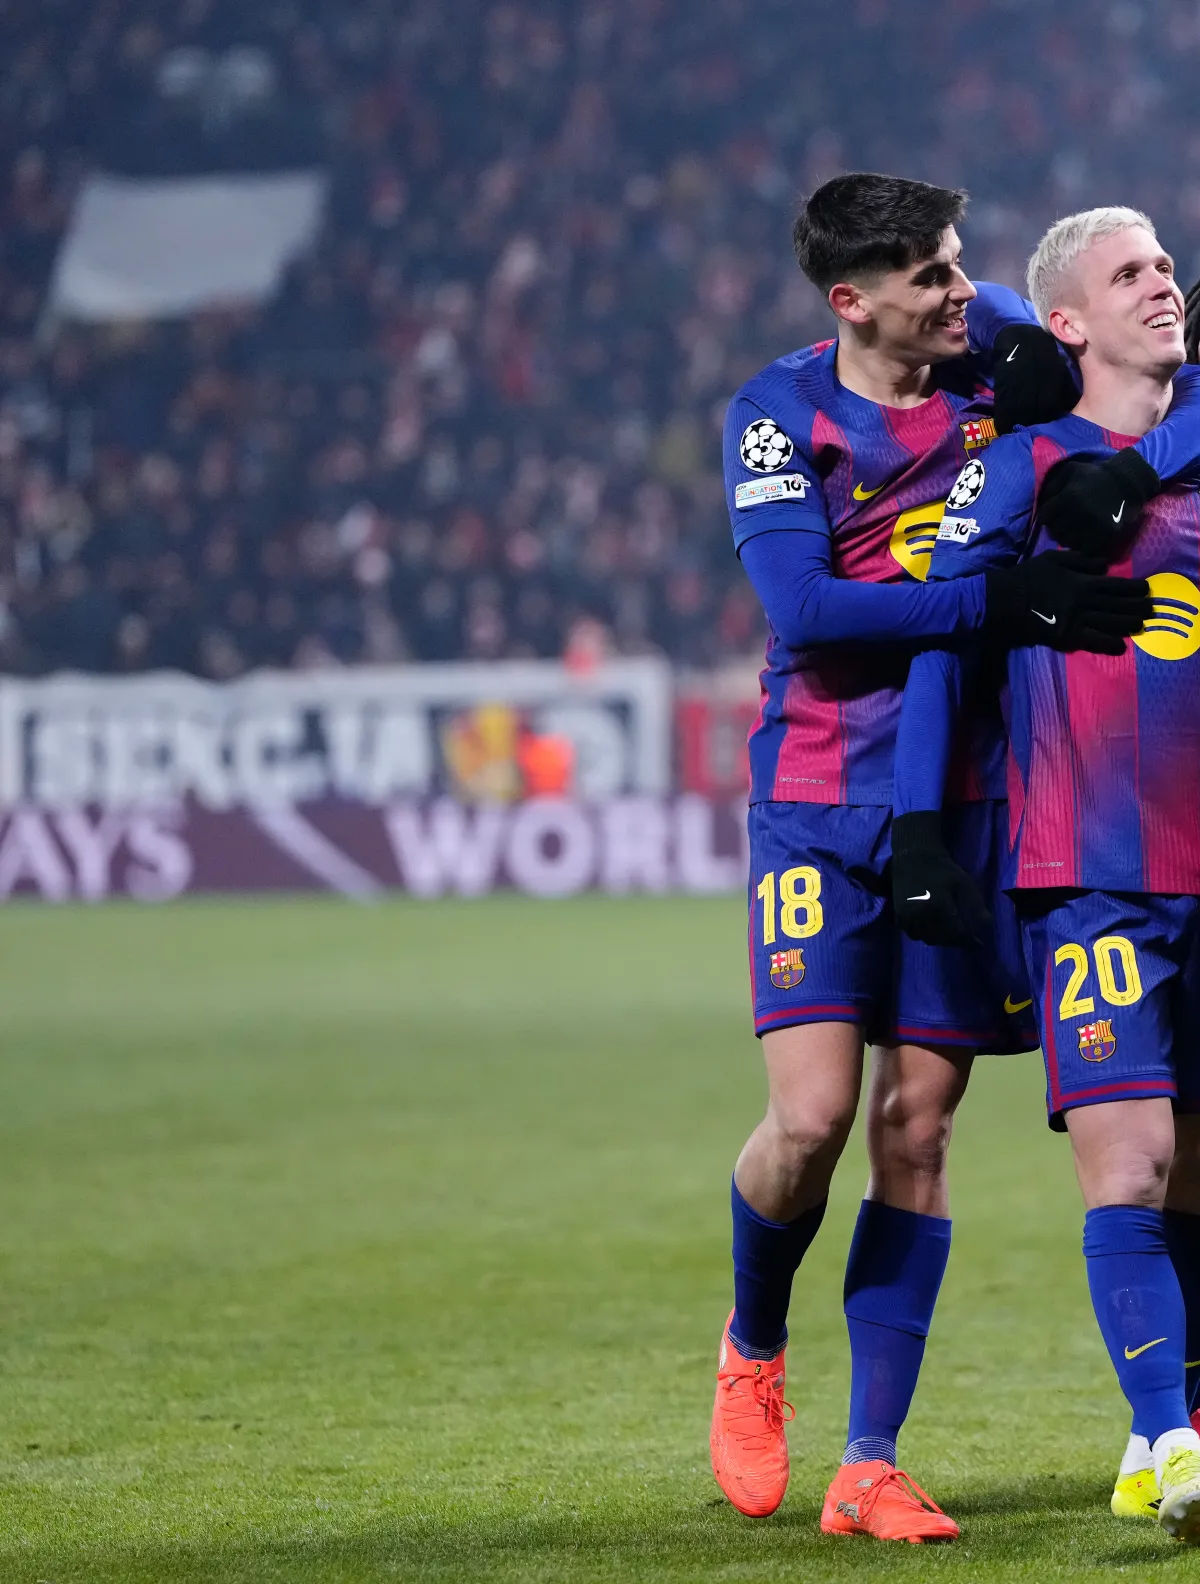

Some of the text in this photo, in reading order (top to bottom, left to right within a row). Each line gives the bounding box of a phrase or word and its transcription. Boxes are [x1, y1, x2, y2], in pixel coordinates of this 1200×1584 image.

[385, 797, 749, 896] WORL
[757, 865, 824, 946] 18
[1054, 935, 1144, 1021] 20
